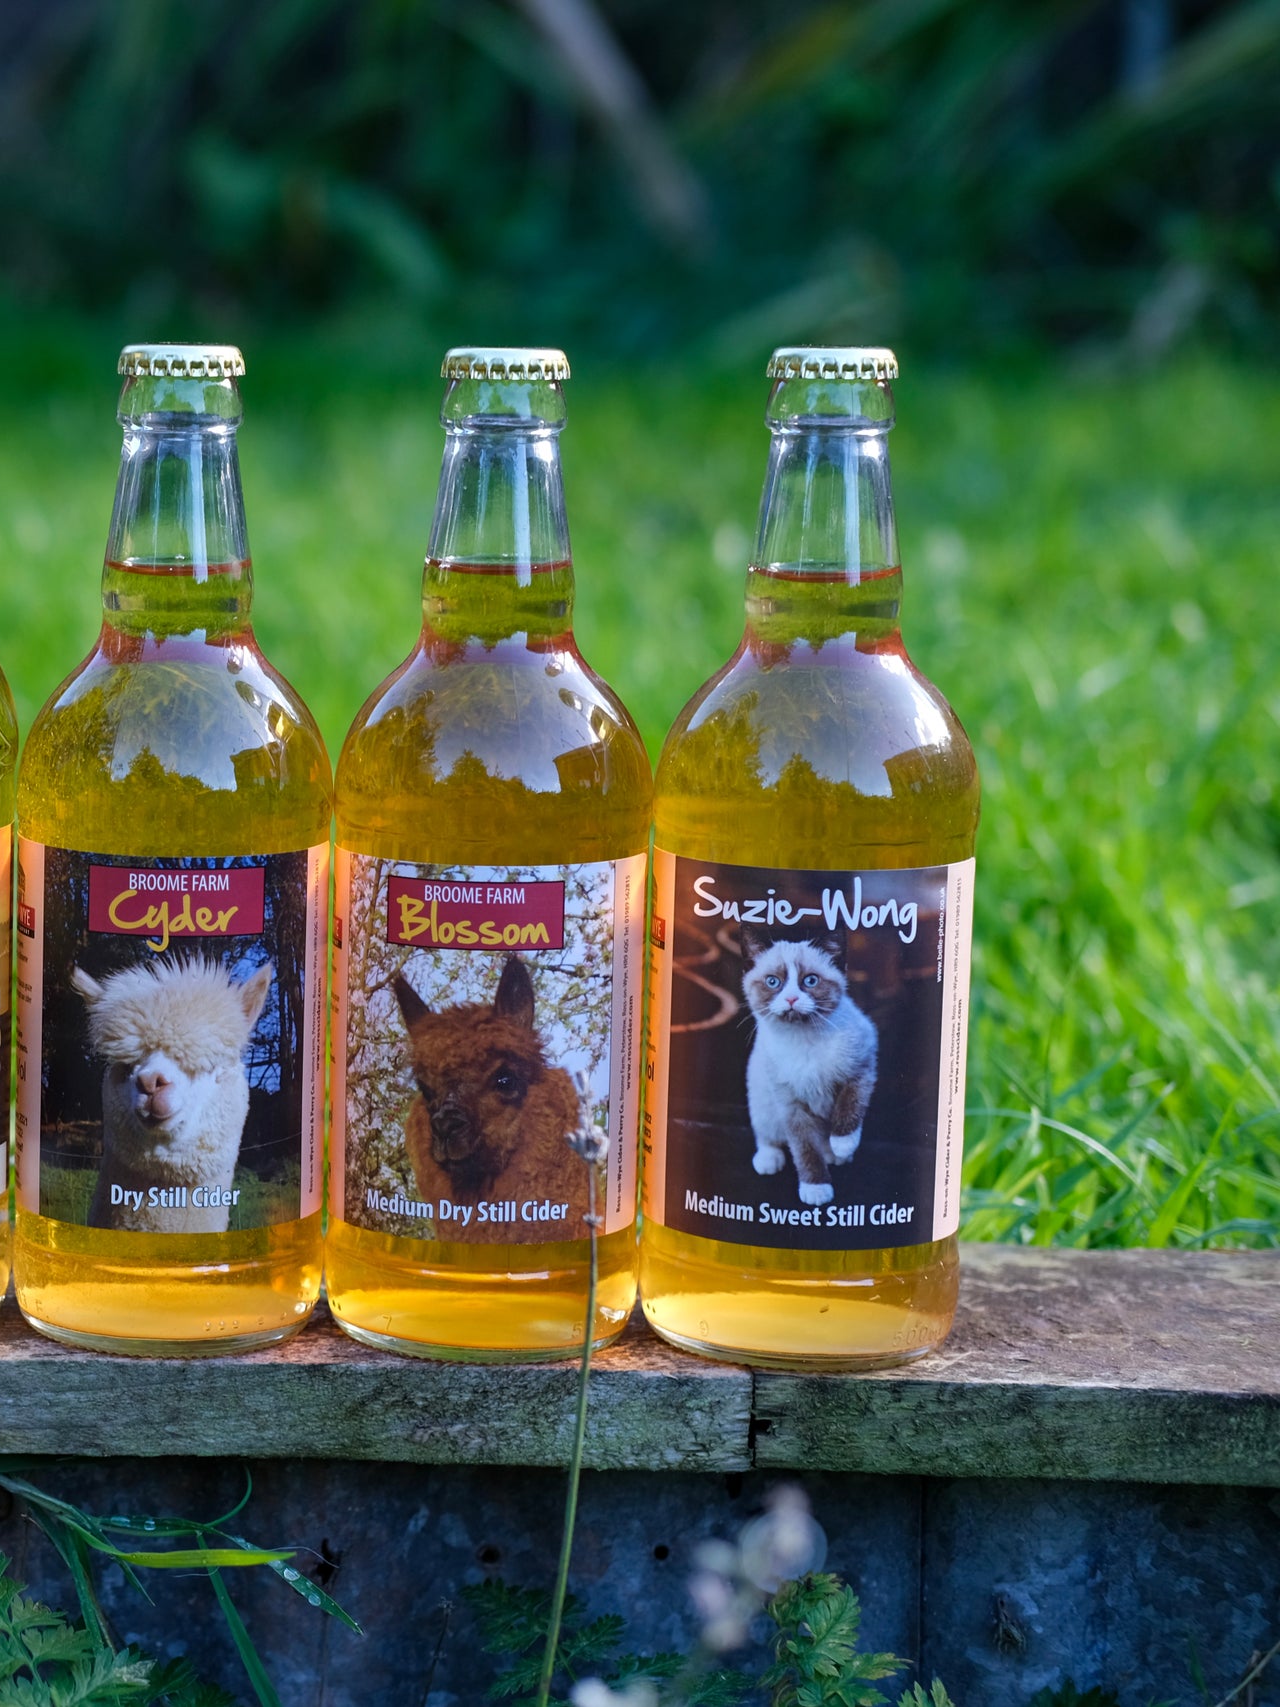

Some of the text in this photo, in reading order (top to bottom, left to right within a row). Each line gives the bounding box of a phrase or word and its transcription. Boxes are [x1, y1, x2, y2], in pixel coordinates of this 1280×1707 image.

[128, 873, 230, 892] BROOME FARM
[423, 883, 526, 905] BROOME FARM
[107, 889, 240, 953] Cyder
[396, 894, 551, 945] Blossom
[692, 875, 919, 944] Suzie-Wong
[936, 887, 946, 984] www.belle-photo.co.uk
[110, 1183, 241, 1213] Dry Still Cider
[366, 1188, 569, 1227] Medium Dry Still Cider
[684, 1188, 915, 1227] Medium Sweet Still Cider
